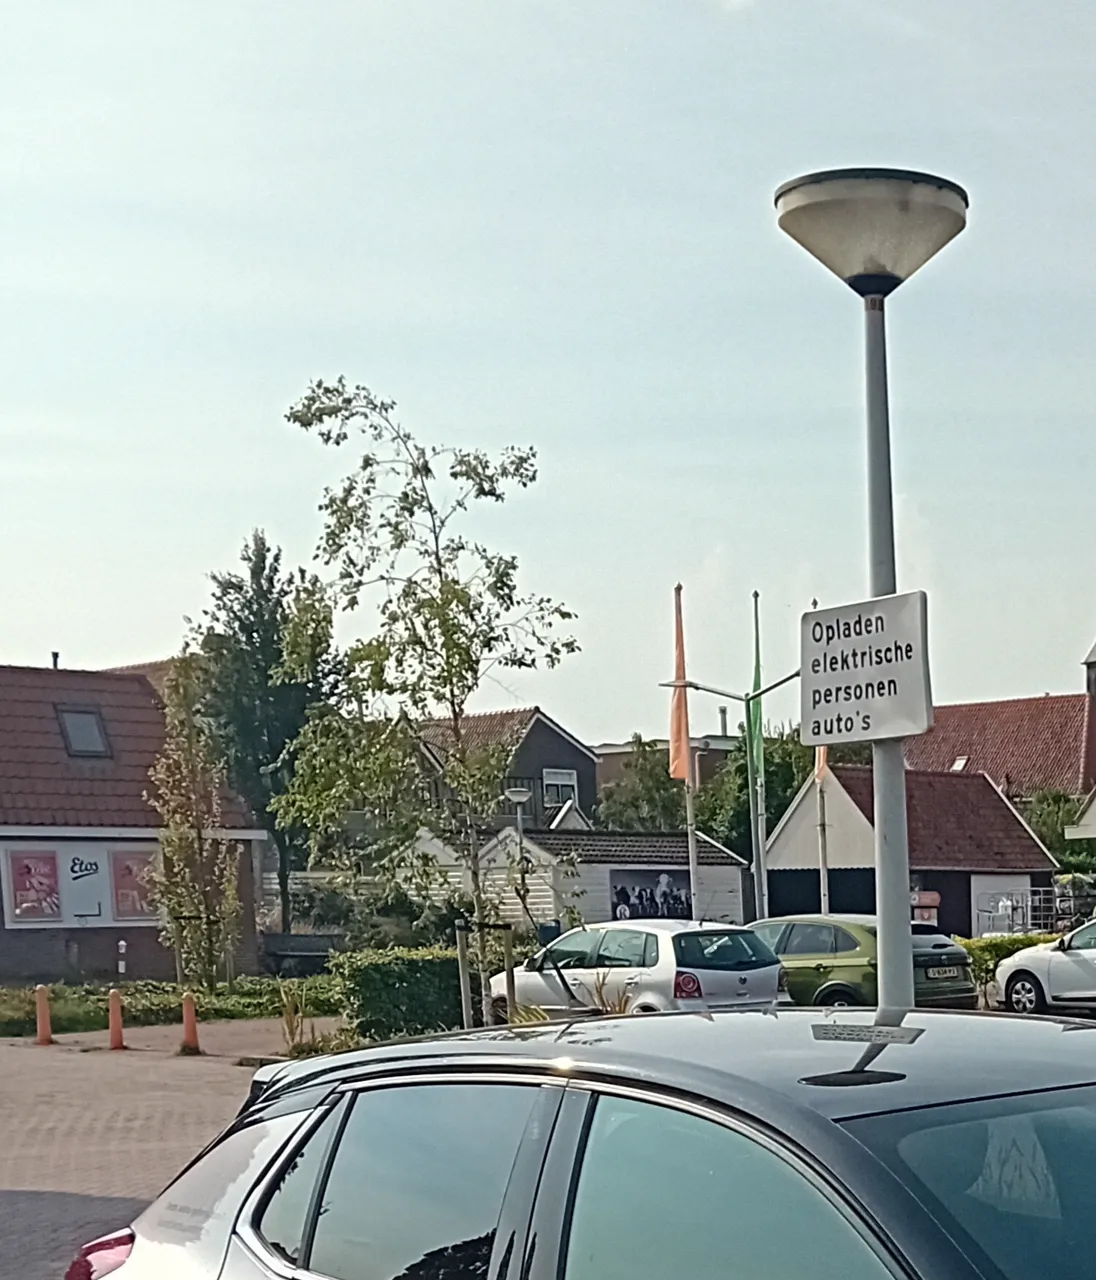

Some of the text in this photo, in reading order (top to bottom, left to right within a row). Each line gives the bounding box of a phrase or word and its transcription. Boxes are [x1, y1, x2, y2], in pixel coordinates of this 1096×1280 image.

[811, 613, 884, 645] Opladen
[811, 640, 913, 674] elektrische
[812, 679, 898, 710] personen
[811, 711, 871, 736] auto's
[70, 857, 99, 876] Etos
